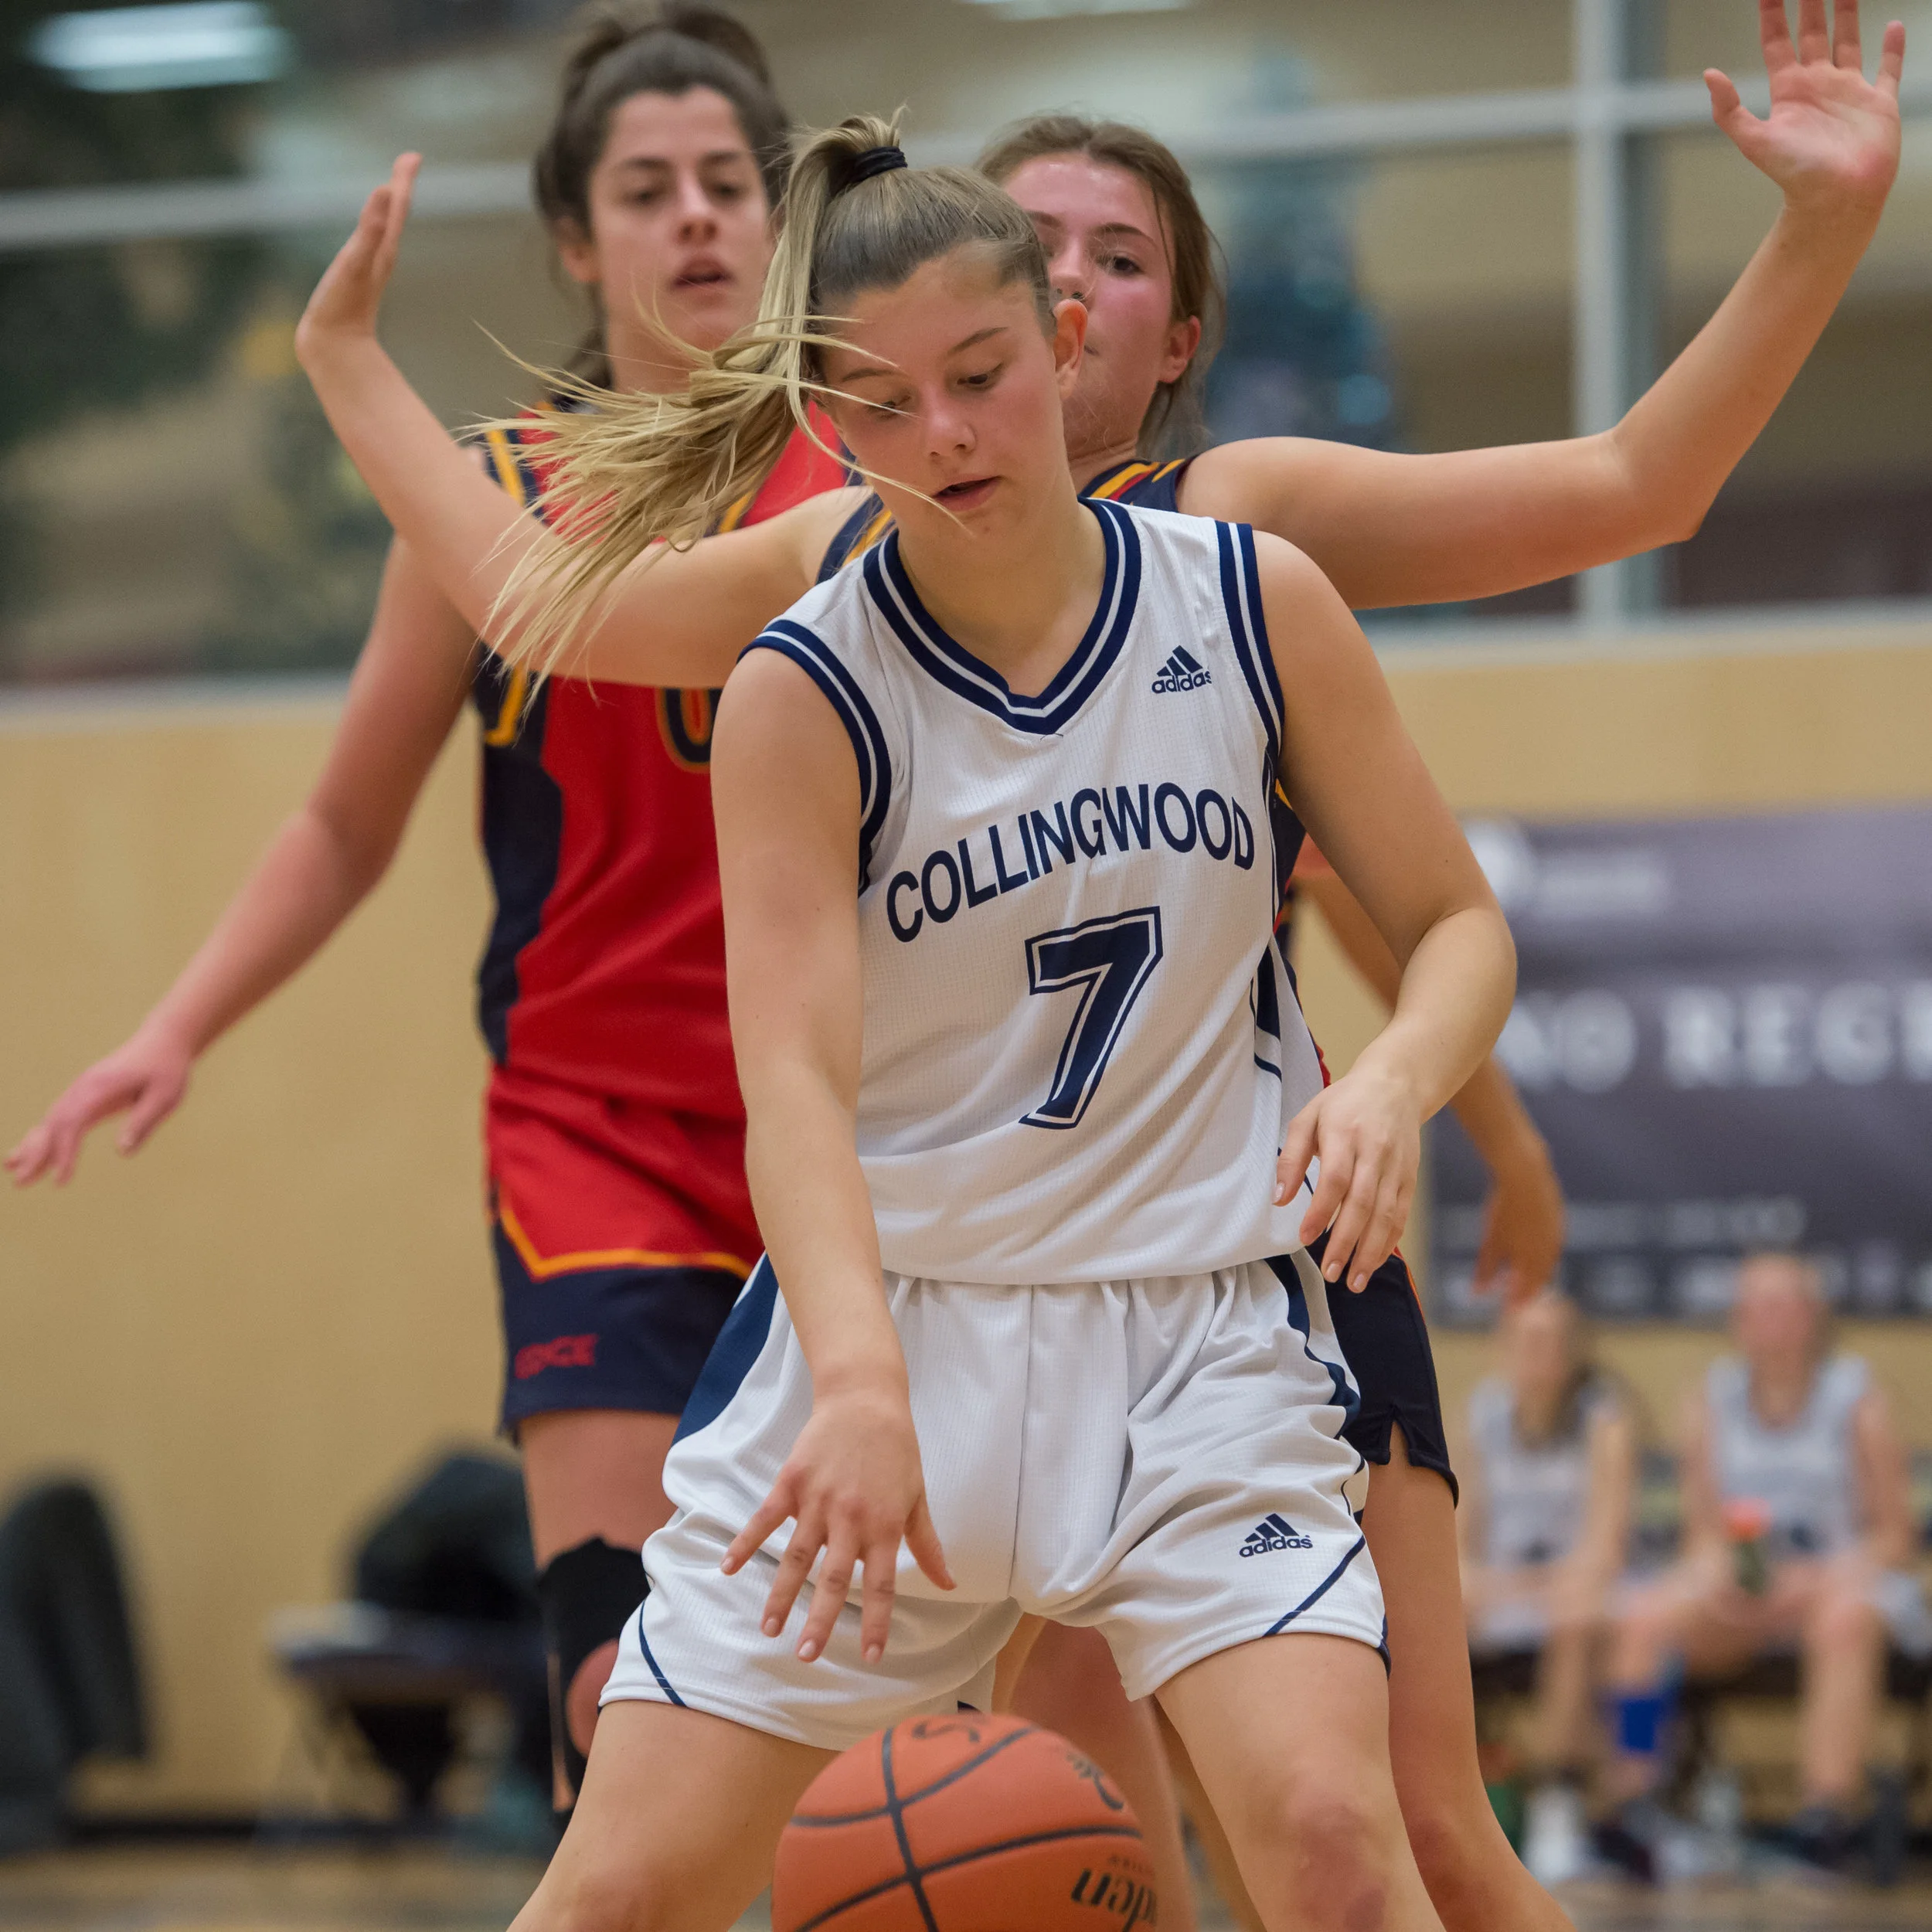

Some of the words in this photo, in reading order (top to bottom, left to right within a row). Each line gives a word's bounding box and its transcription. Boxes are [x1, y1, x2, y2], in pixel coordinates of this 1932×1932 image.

[1151, 671, 1212, 694] adidas
[886, 782, 1254, 943] COLLINGWOOD
[1019, 906, 1163, 1129] 7
[1239, 1535, 1313, 1557] adidas
